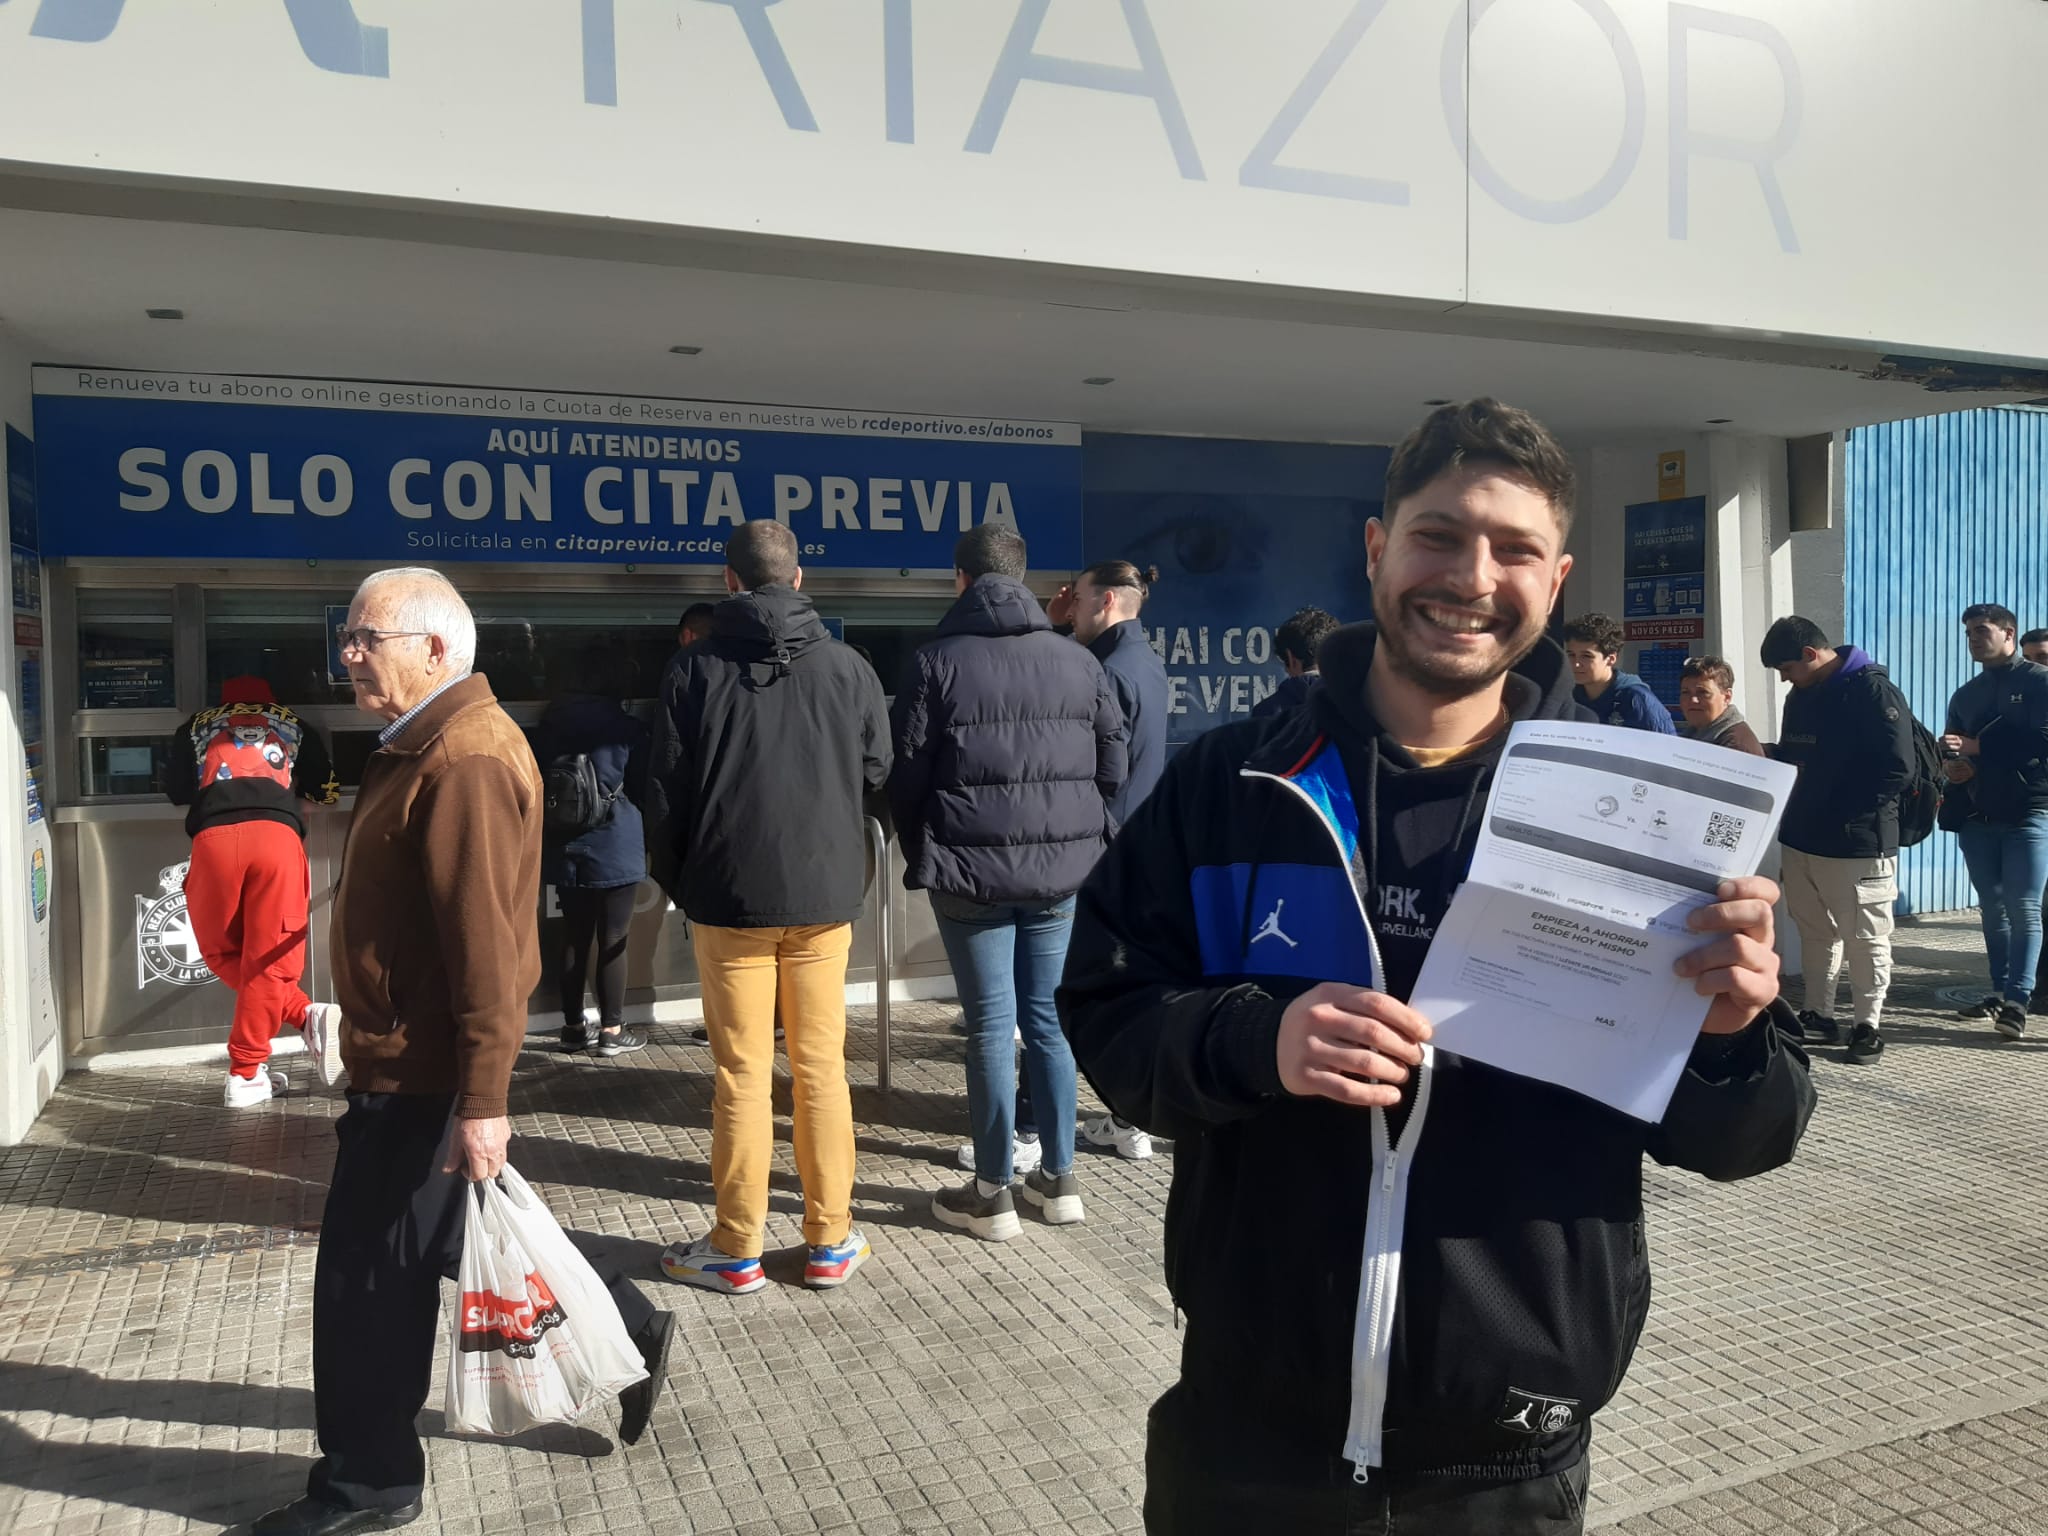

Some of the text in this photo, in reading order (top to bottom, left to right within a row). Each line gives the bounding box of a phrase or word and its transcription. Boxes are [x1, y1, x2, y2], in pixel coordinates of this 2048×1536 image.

[78, 372, 1054, 440] Renueva tu abono online gestionando la Cuota de Reserva en nuestra web rcdeportivo.es/abonos
[487, 427, 742, 462] AQUÍ ATENDEMOS
[117, 446, 1020, 533] SOLO CON CITA PREVIA
[406, 530, 825, 557] Solicítala en citaprevia.rcde.es
[147, 908, 169, 931] REAL
[1531, 911, 1580, 931] EMPIEZA
[1582, 925, 1591, 934] A
[1592, 928, 1649, 949] AHORRAR
[1532, 922, 1570, 939] DESDE
[1572, 933, 1598, 946] HOY
[1597, 940, 1636, 957] MISMO
[178, 967, 191, 980] LA
